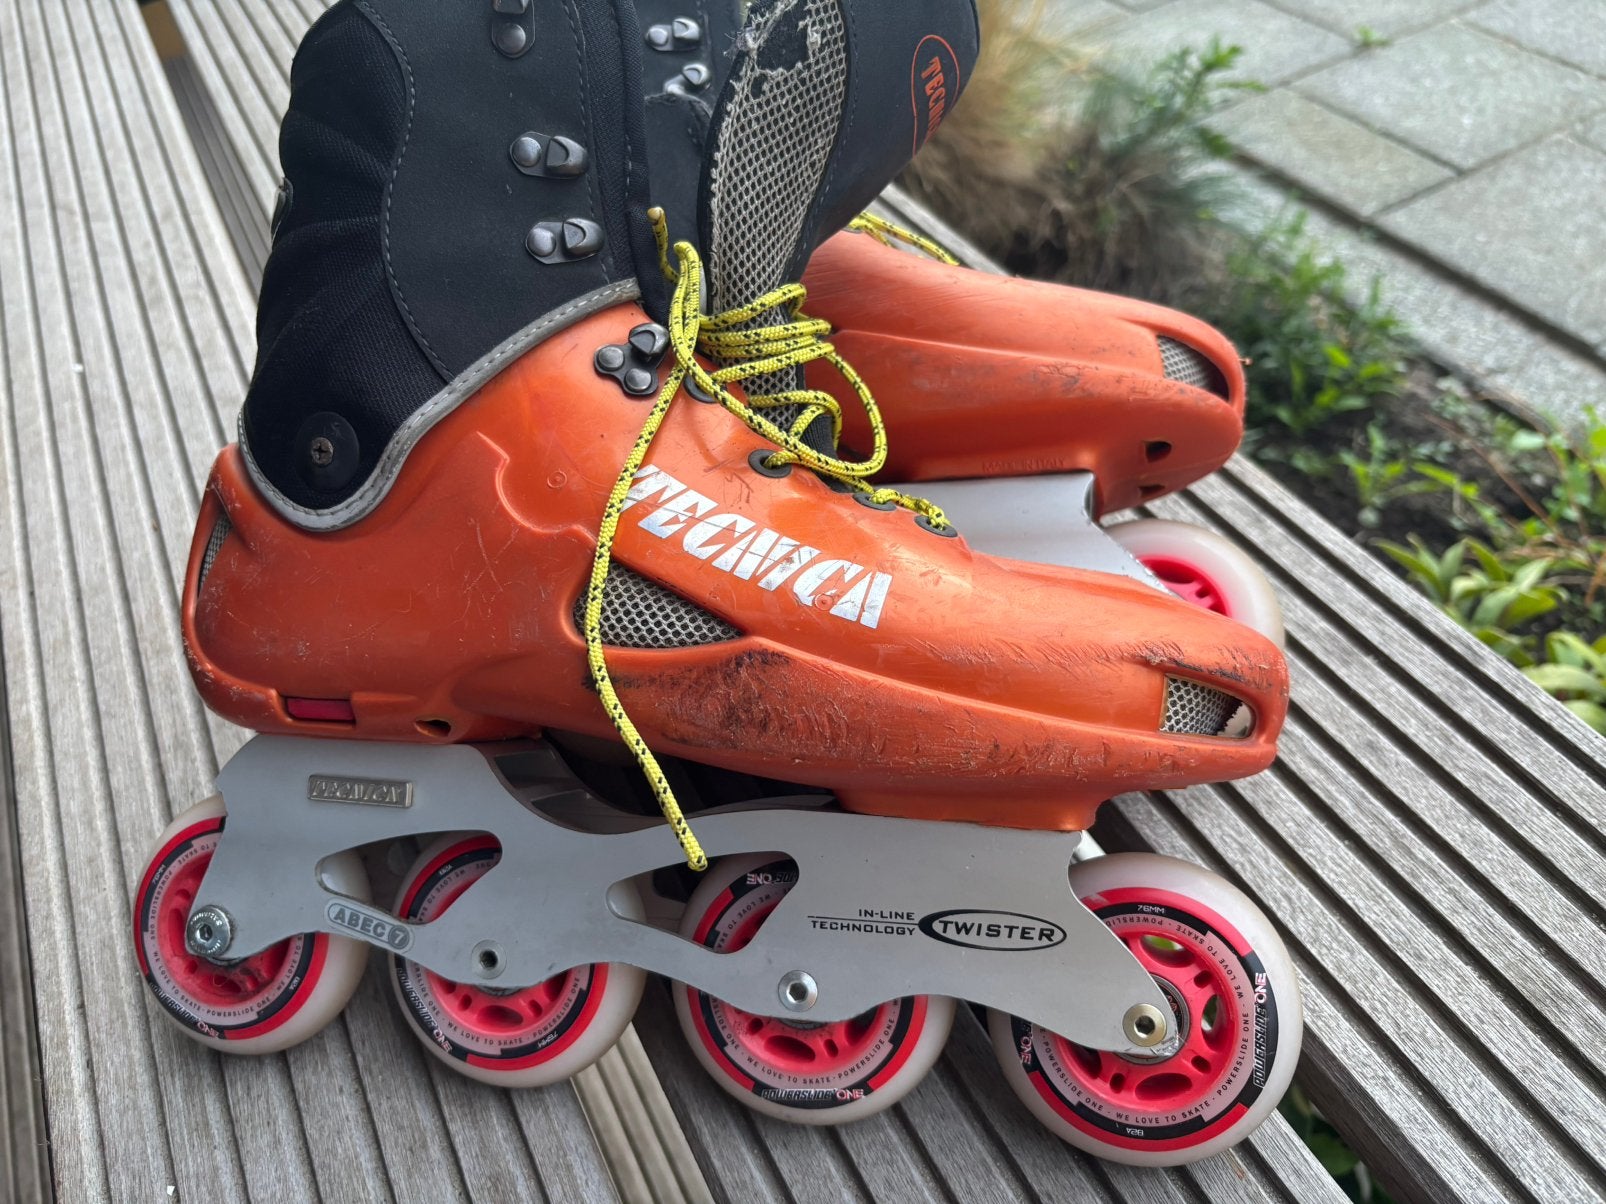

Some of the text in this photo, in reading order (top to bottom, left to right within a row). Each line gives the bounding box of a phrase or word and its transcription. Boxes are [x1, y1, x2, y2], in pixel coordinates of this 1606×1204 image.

[618, 463, 893, 629] TECNICA
[857, 908, 915, 921] IN-LINE
[1136, 904, 1166, 914] 76MM
[333, 907, 406, 944] ABEC 7
[810, 919, 917, 937] TECHNOLOGY
[937, 919, 1056, 943] TWISTER
[206, 1006, 254, 1018] POWERSLIDE
[461, 1031, 481, 1042] LOVE
[532, 997, 573, 1038] POWERSLIDE
[1043, 916, 1249, 1124] POWERSLIDE ONE WE LOVE TO SKATE POWERSLIDE ONE WE LOVE TO SKATE POWERSLID
[197, 1020, 220, 1038] ONE
[433, 1028, 453, 1053] ONE
[1252, 972, 1268, 1088] POWERSLIDE ONE
[726, 1033, 740, 1050] ONE
[746, 1056, 758, 1068] WE
[761, 1065, 783, 1080] LOVE
[802, 1076, 831, 1084] SKATE
[837, 1038, 885, 1079] POWERSLIDE
[1021, 1036, 1032, 1064] ONE
[835, 1088, 865, 1100] ONE
